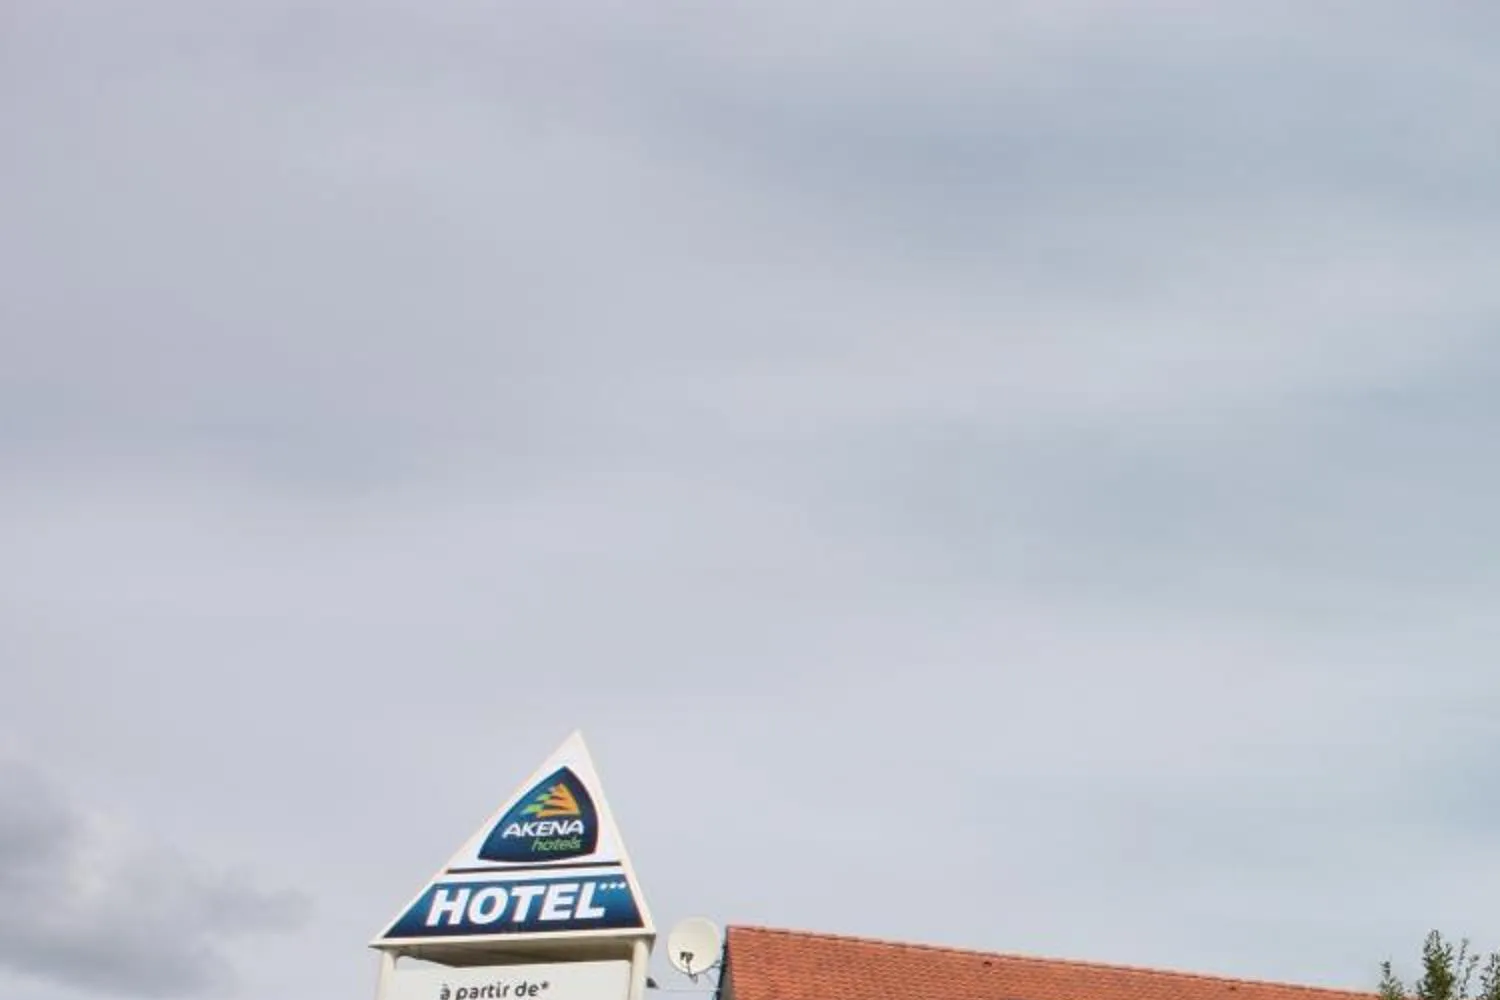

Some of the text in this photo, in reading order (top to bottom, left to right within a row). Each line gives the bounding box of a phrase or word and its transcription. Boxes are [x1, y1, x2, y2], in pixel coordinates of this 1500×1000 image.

[502, 820, 585, 839] AKENA
[531, 836, 581, 852] hotels
[425, 882, 606, 927] HOTEL
[440, 983, 451, 1000] à
